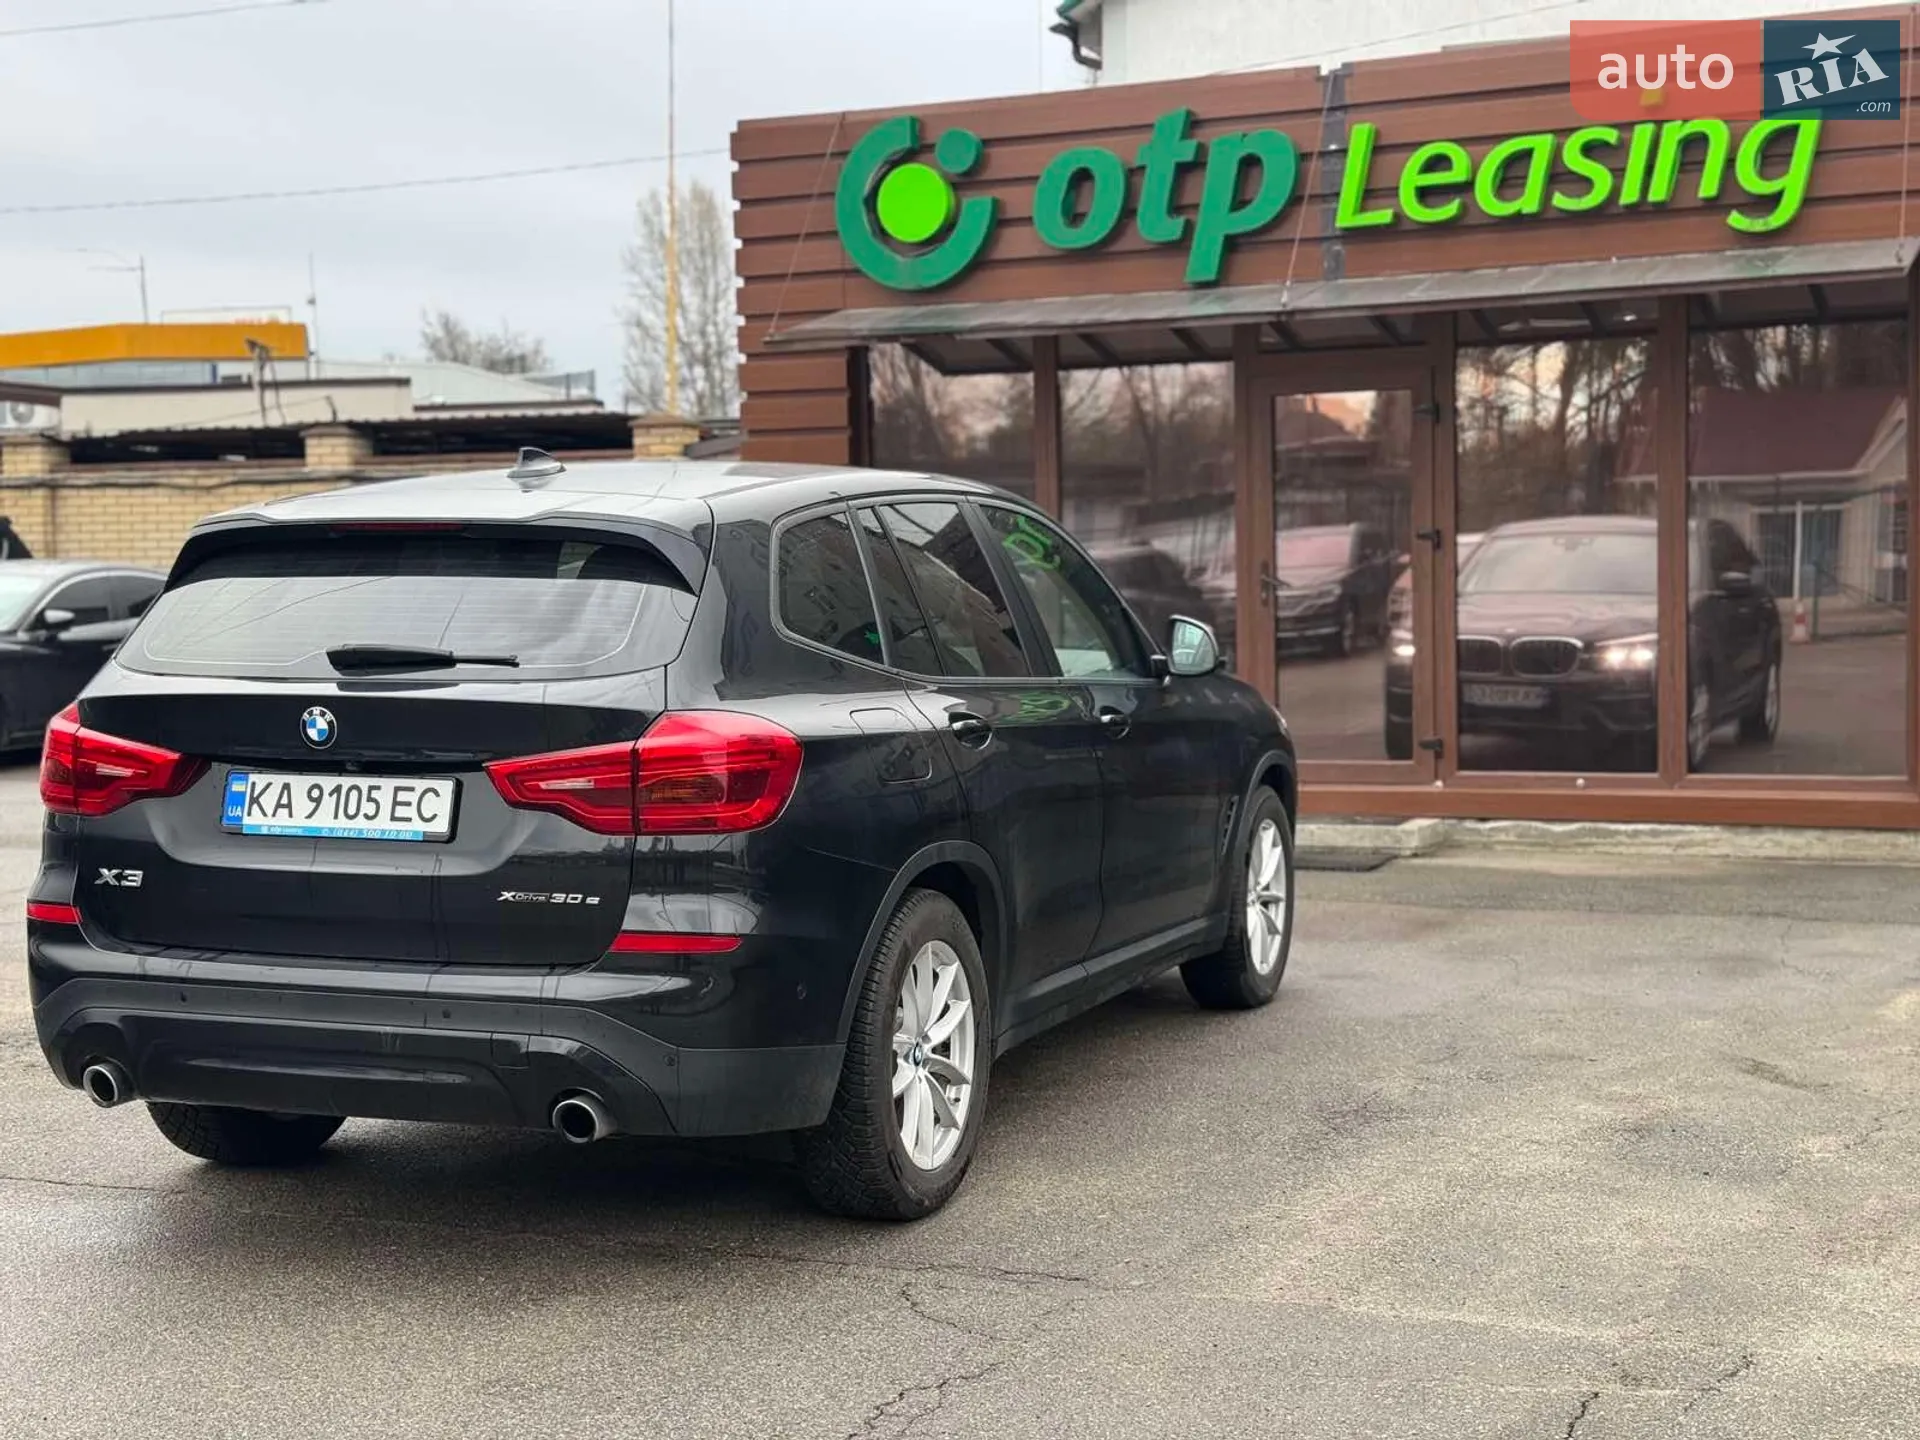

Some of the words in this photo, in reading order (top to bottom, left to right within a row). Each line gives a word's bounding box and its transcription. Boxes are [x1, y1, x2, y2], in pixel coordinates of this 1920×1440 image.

[1032, 106, 1300, 284] otp
[1336, 93, 1823, 233] Leasing
[228, 804, 242, 817] UA
[246, 781, 293, 818] KA
[304, 783, 382, 821] 9105
[389, 785, 441, 823] EC
[94, 867, 144, 887] X3
